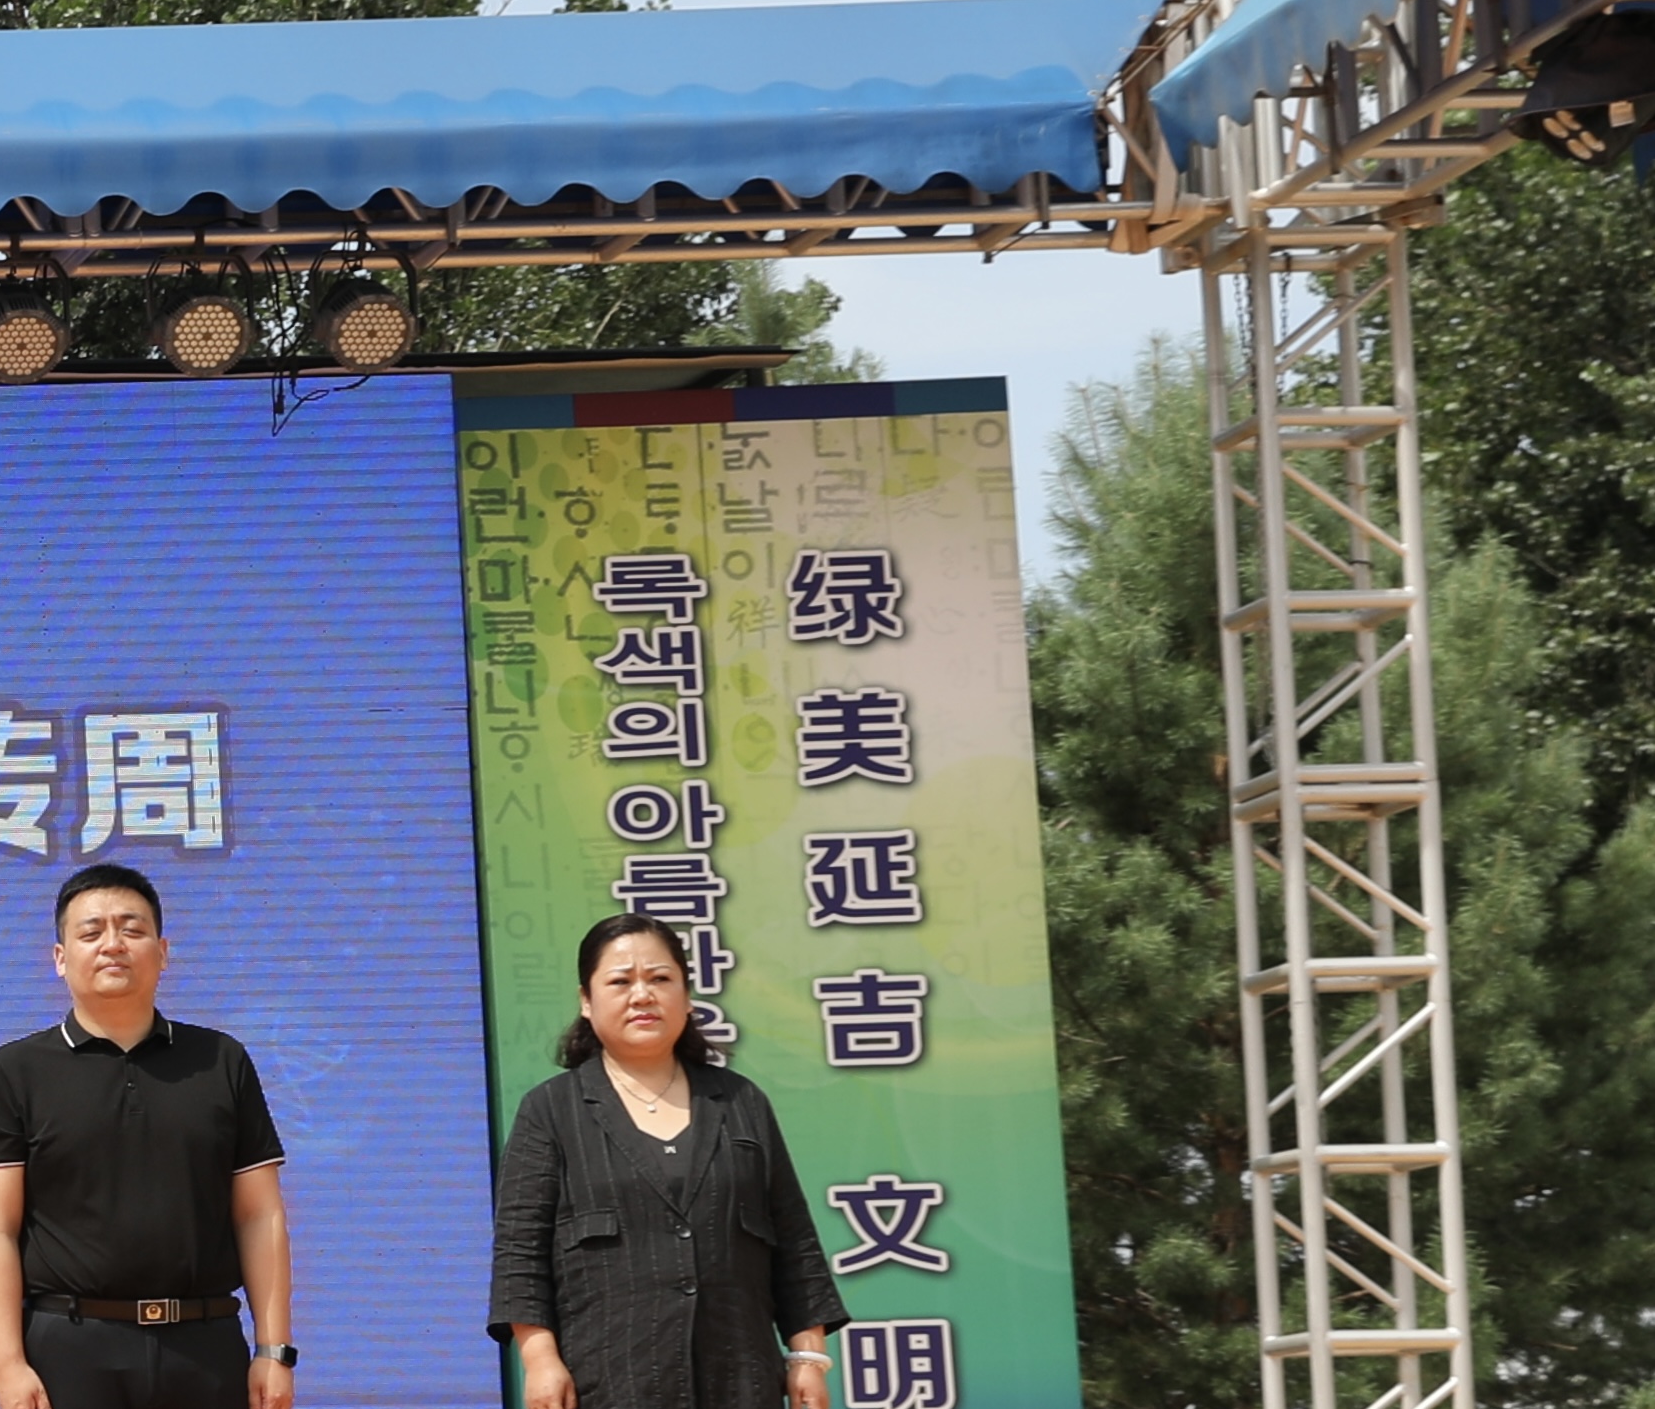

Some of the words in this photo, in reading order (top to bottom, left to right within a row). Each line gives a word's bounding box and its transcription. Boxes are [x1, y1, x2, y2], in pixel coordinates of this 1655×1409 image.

[594, 554, 708, 765] 록색의
[787, 548, 930, 1067] 绿美延吉
